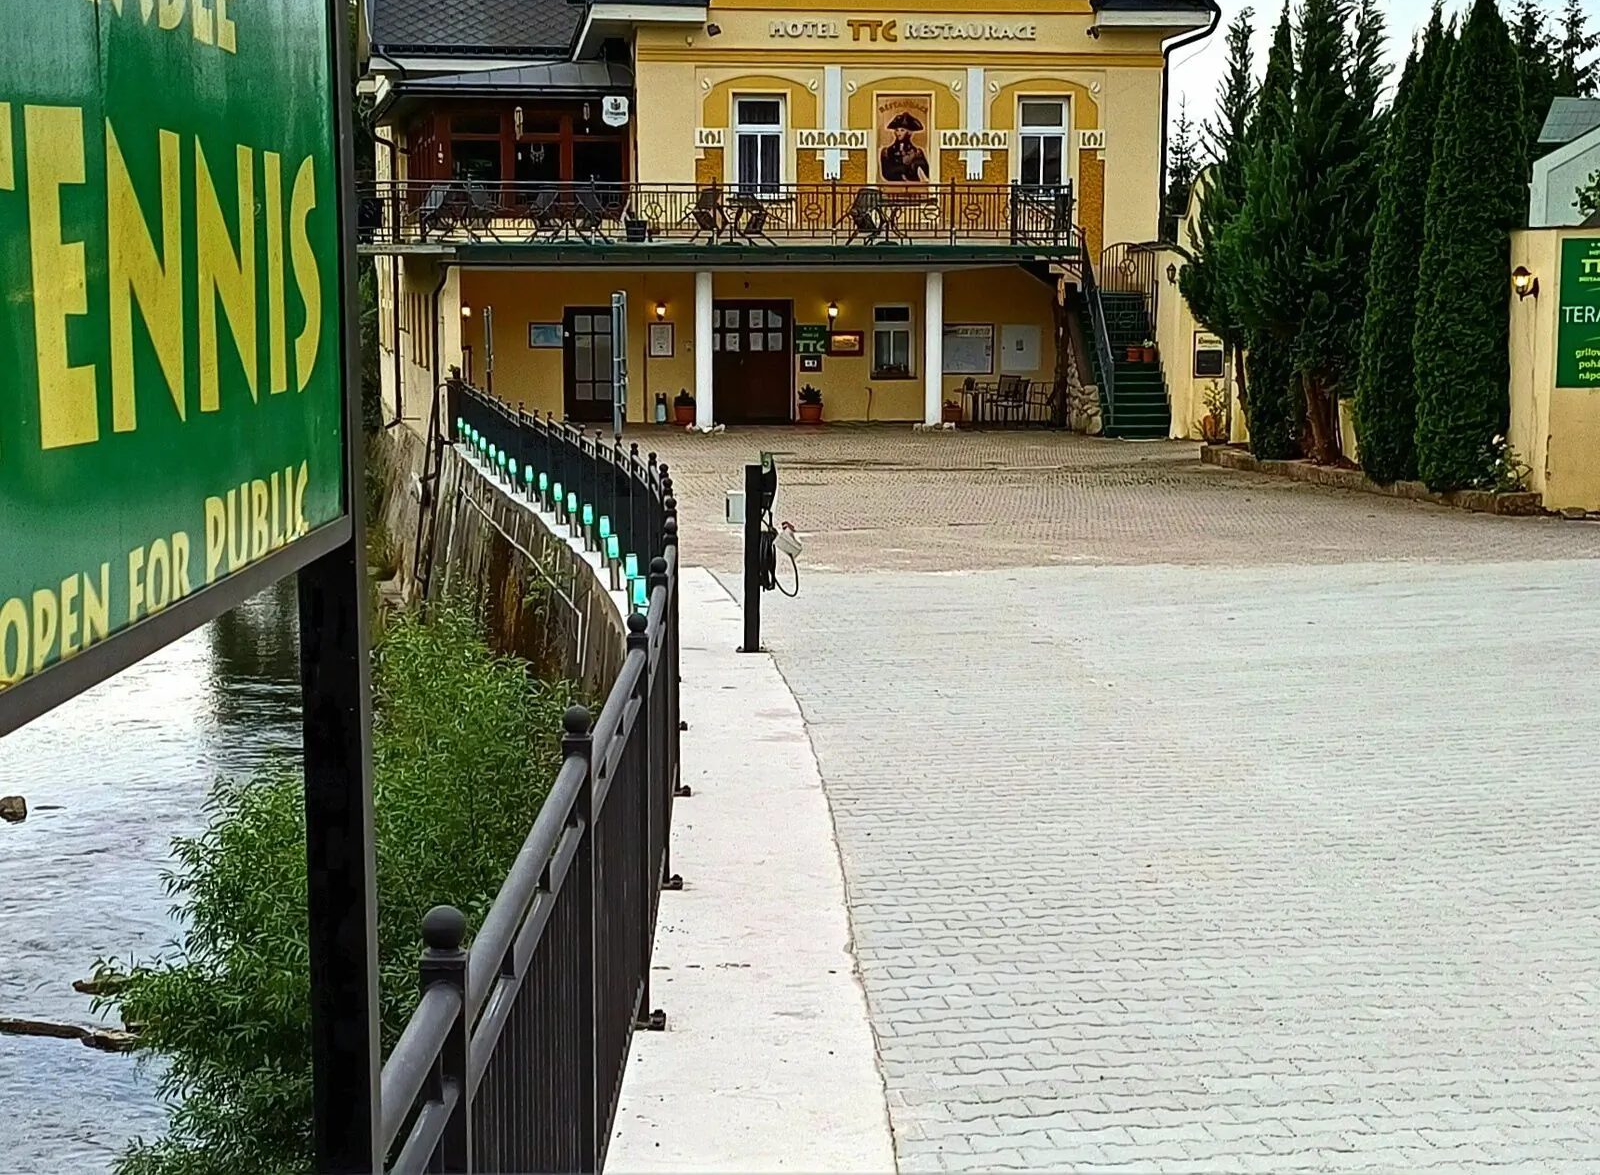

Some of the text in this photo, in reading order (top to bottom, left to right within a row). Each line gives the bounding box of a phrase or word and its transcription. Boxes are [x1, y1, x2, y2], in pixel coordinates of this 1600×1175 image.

[847, 19, 898, 42] TTC
[904, 22, 1037, 41] RESTAURACE
[796, 339, 825, 353] TTC
[0, 459, 310, 688] OPEN FOR PUBLIC
